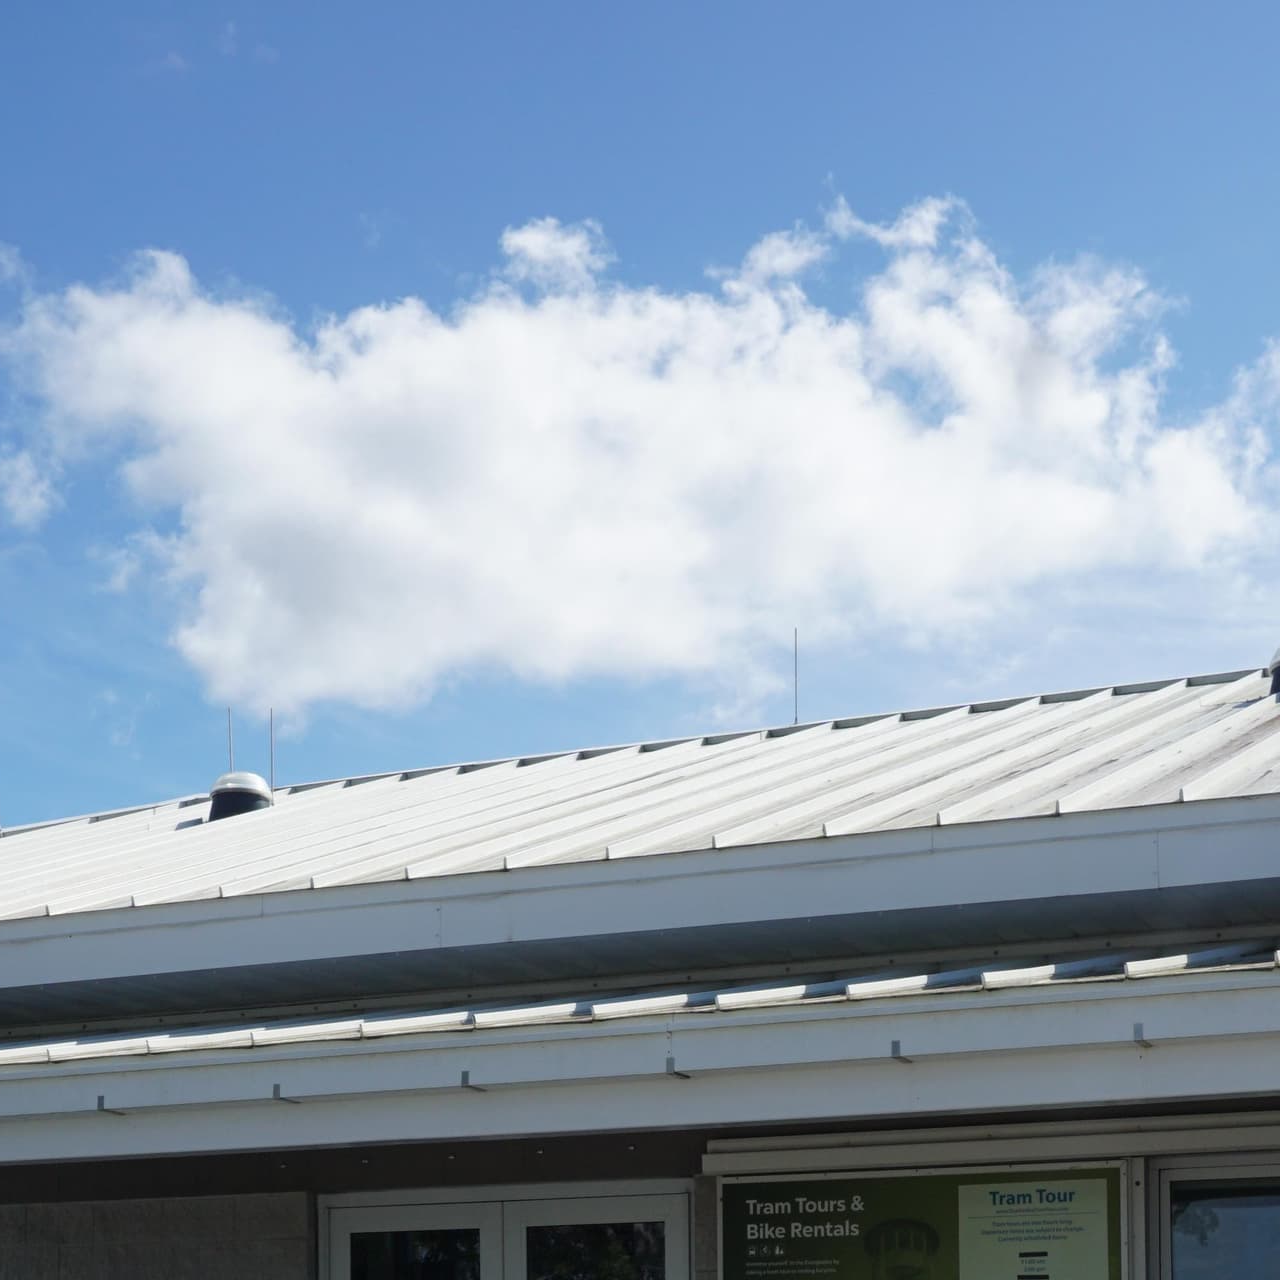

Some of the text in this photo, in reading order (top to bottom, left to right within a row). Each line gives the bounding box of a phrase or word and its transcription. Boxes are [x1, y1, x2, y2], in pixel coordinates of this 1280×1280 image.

[745, 1195, 865, 1216] Tram Tours &
[989, 1188, 1076, 1206] Tram Tour
[746, 1220, 860, 1240] Bike Rentals
